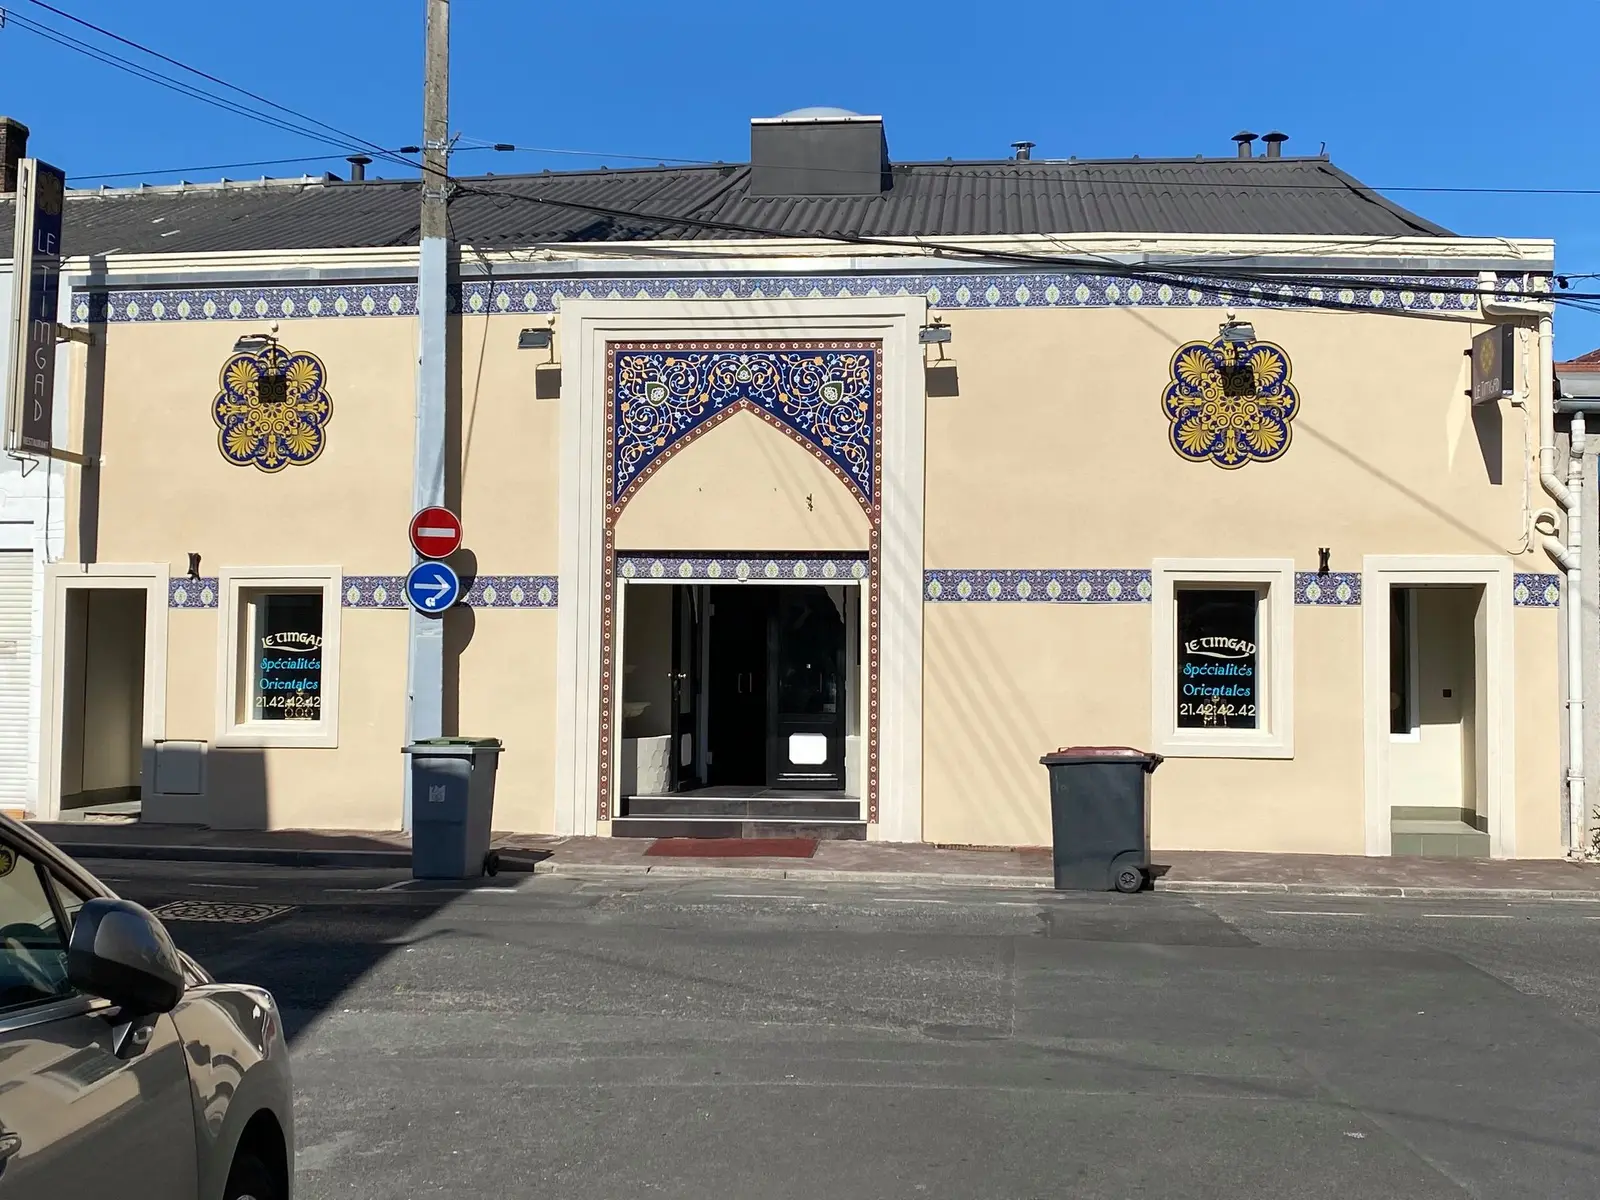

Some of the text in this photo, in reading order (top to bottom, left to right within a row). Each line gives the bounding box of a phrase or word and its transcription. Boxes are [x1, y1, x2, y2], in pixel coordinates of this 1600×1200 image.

[33, 229, 56, 422] LE TIMGAD
[1474, 384, 1481, 399] LE
[22, 435, 50, 449] RESTAURANT
[261, 632, 323, 648] LE TIMGAD
[1184, 636, 1256, 655] LE TIMGAD
[260, 657, 321, 672] Spécialités
[1183, 663, 1253, 678] Spécialités
[259, 678, 319, 690] Orientales
[1183, 683, 1251, 697] Orientales
[1180, 703, 1256, 717] 21.42.42.42
